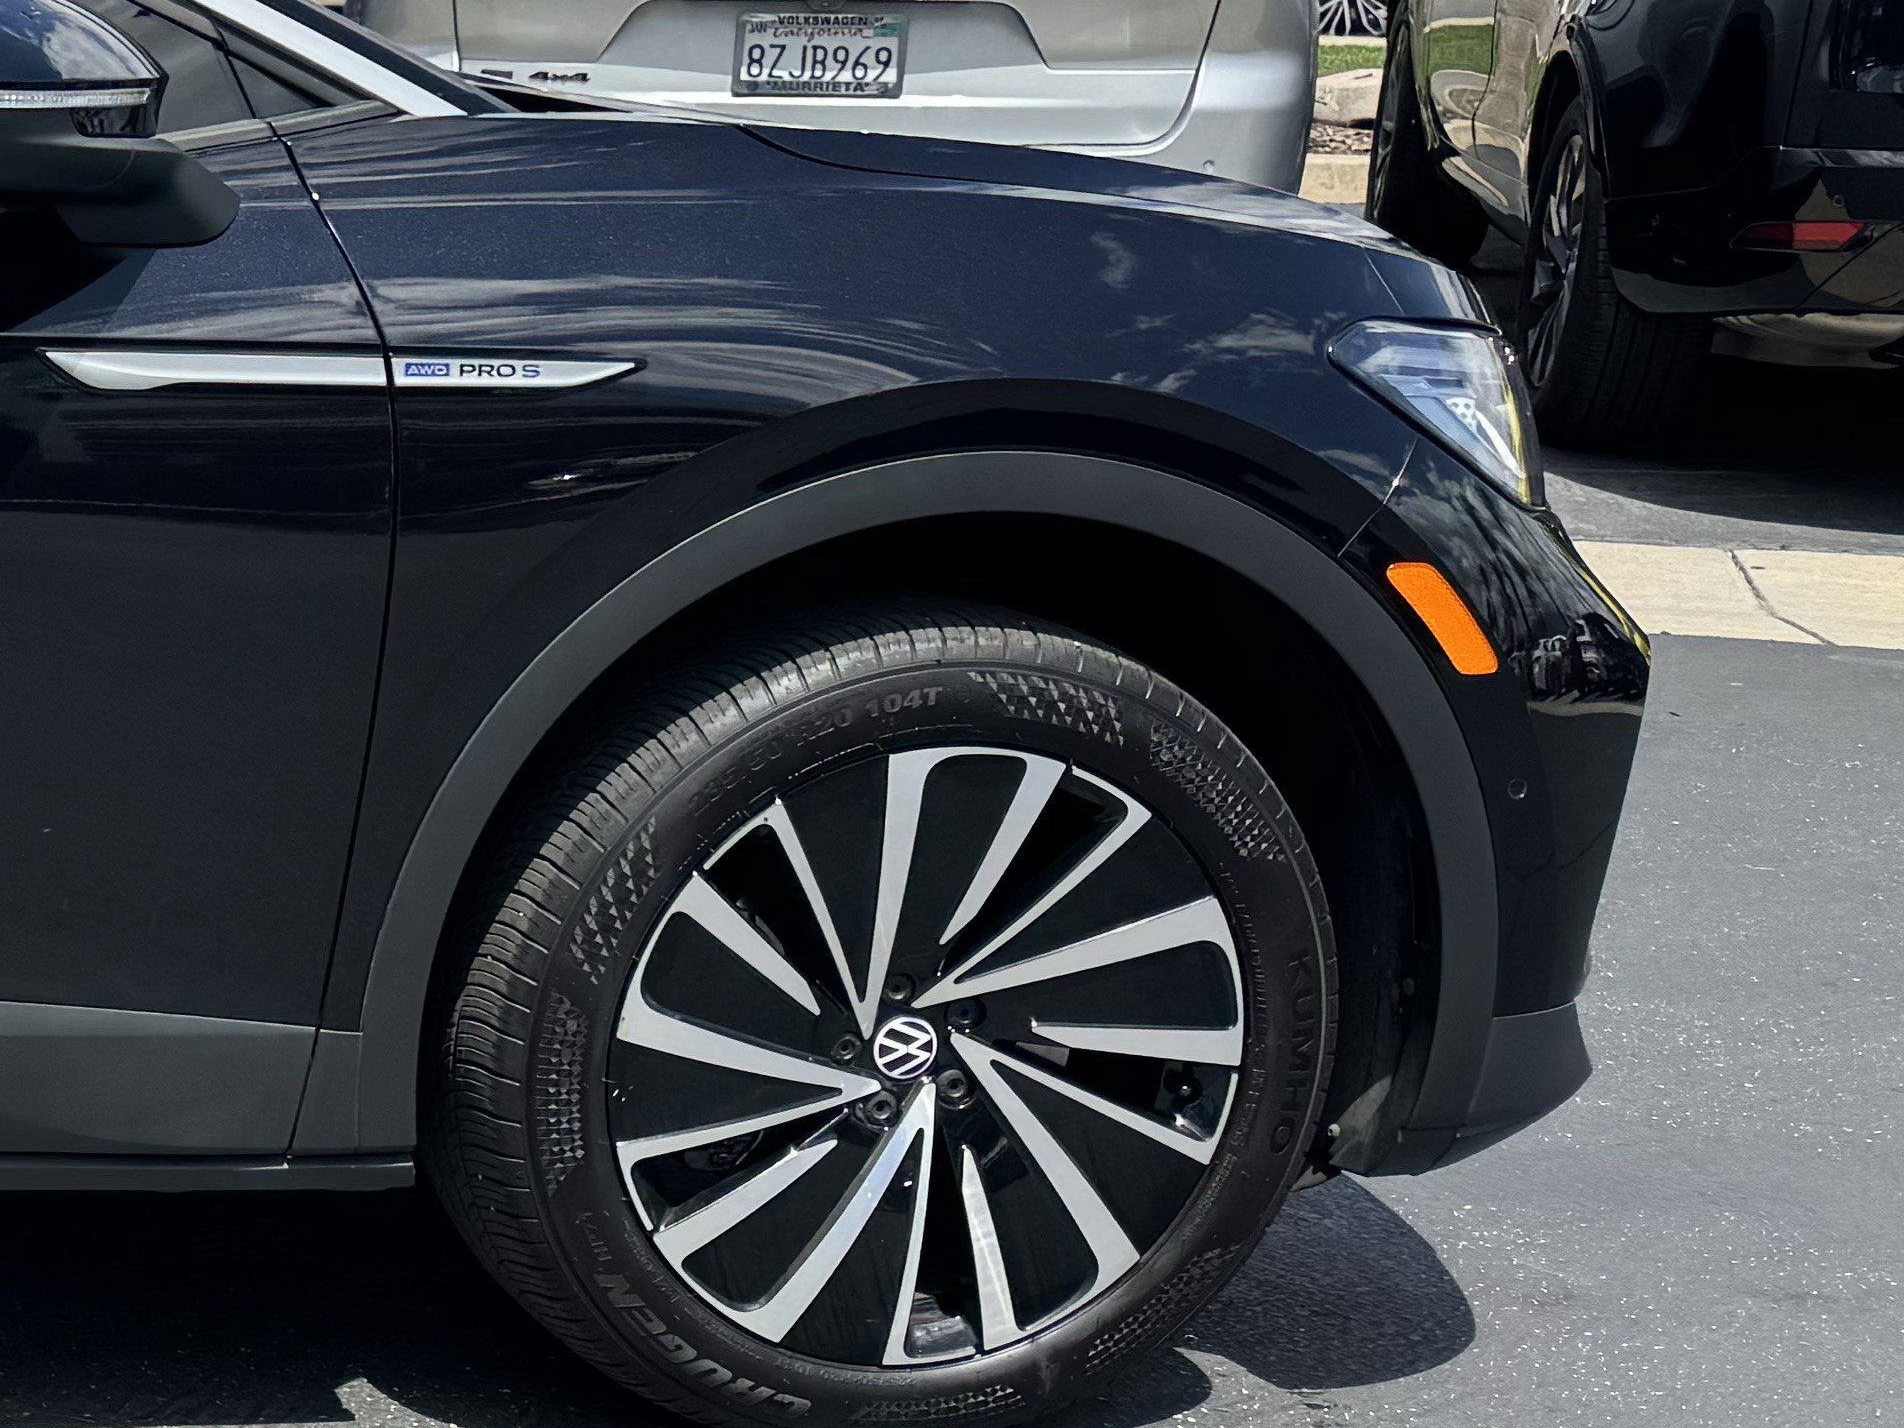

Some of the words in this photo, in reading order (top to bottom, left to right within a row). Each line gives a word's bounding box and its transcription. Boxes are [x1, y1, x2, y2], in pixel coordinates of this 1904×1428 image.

[777, 15, 869, 27] VOLKSWAGEN
[746, 43, 893, 83] 8ZJB969
[770, 80, 867, 94] MURRIETA
[406, 364, 448, 376] AWD
[459, 363, 516, 378] PRO
[521, 363, 541, 379] S
[866, 685, 943, 718] 104T
[593, 1273, 812, 1419] CRUGEN
